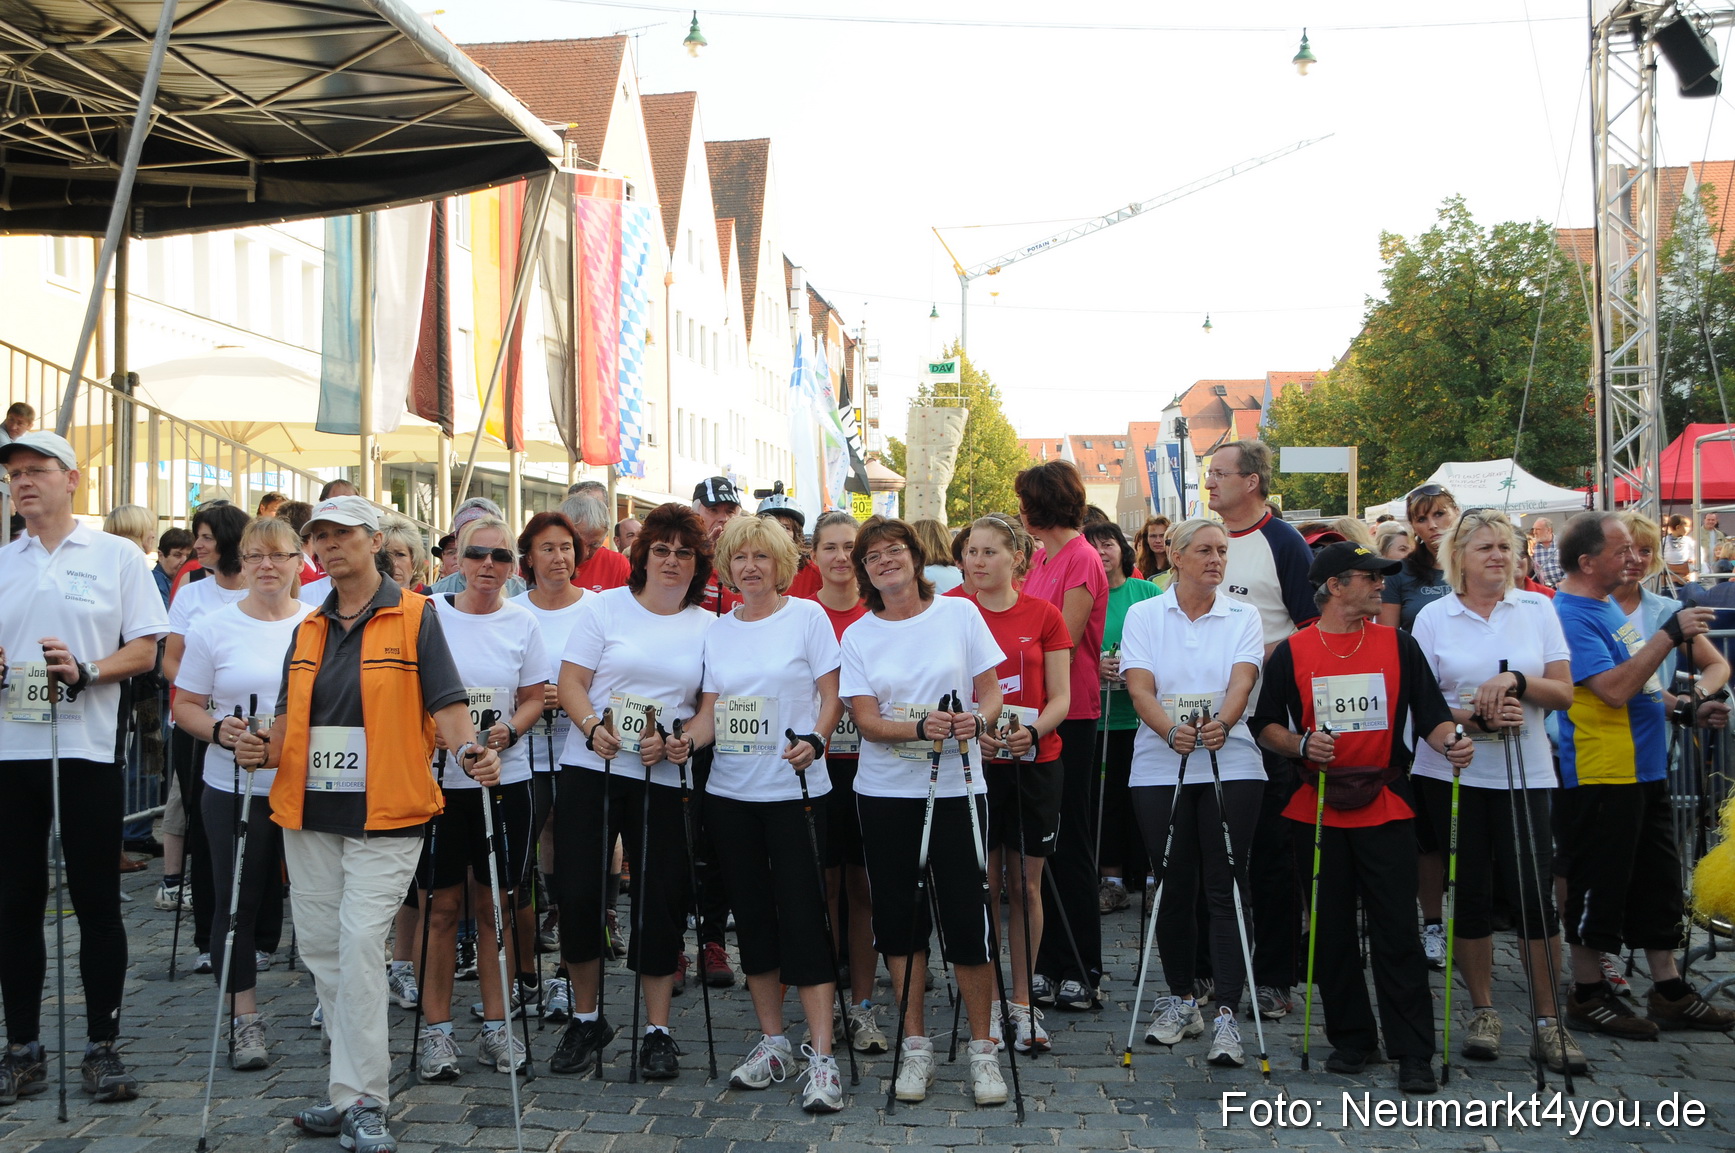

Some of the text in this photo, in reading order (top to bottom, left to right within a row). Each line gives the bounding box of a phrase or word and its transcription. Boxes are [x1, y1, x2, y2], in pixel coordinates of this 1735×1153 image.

[1027, 241, 1050, 252] POTAIN
[932, 363, 953, 373] DAV
[66, 570, 97, 581] Walking
[10, 684, 16, 692] N
[468, 693, 491, 705] igitte
[1317, 699, 1322, 707] N
[1335, 696, 1378, 713] 8101
[729, 700, 756, 712] Christl
[622, 716, 644, 734] 80
[730, 718, 769, 735] 8001
[836, 720, 856, 735] 80
[313, 751, 359, 769] 8122
